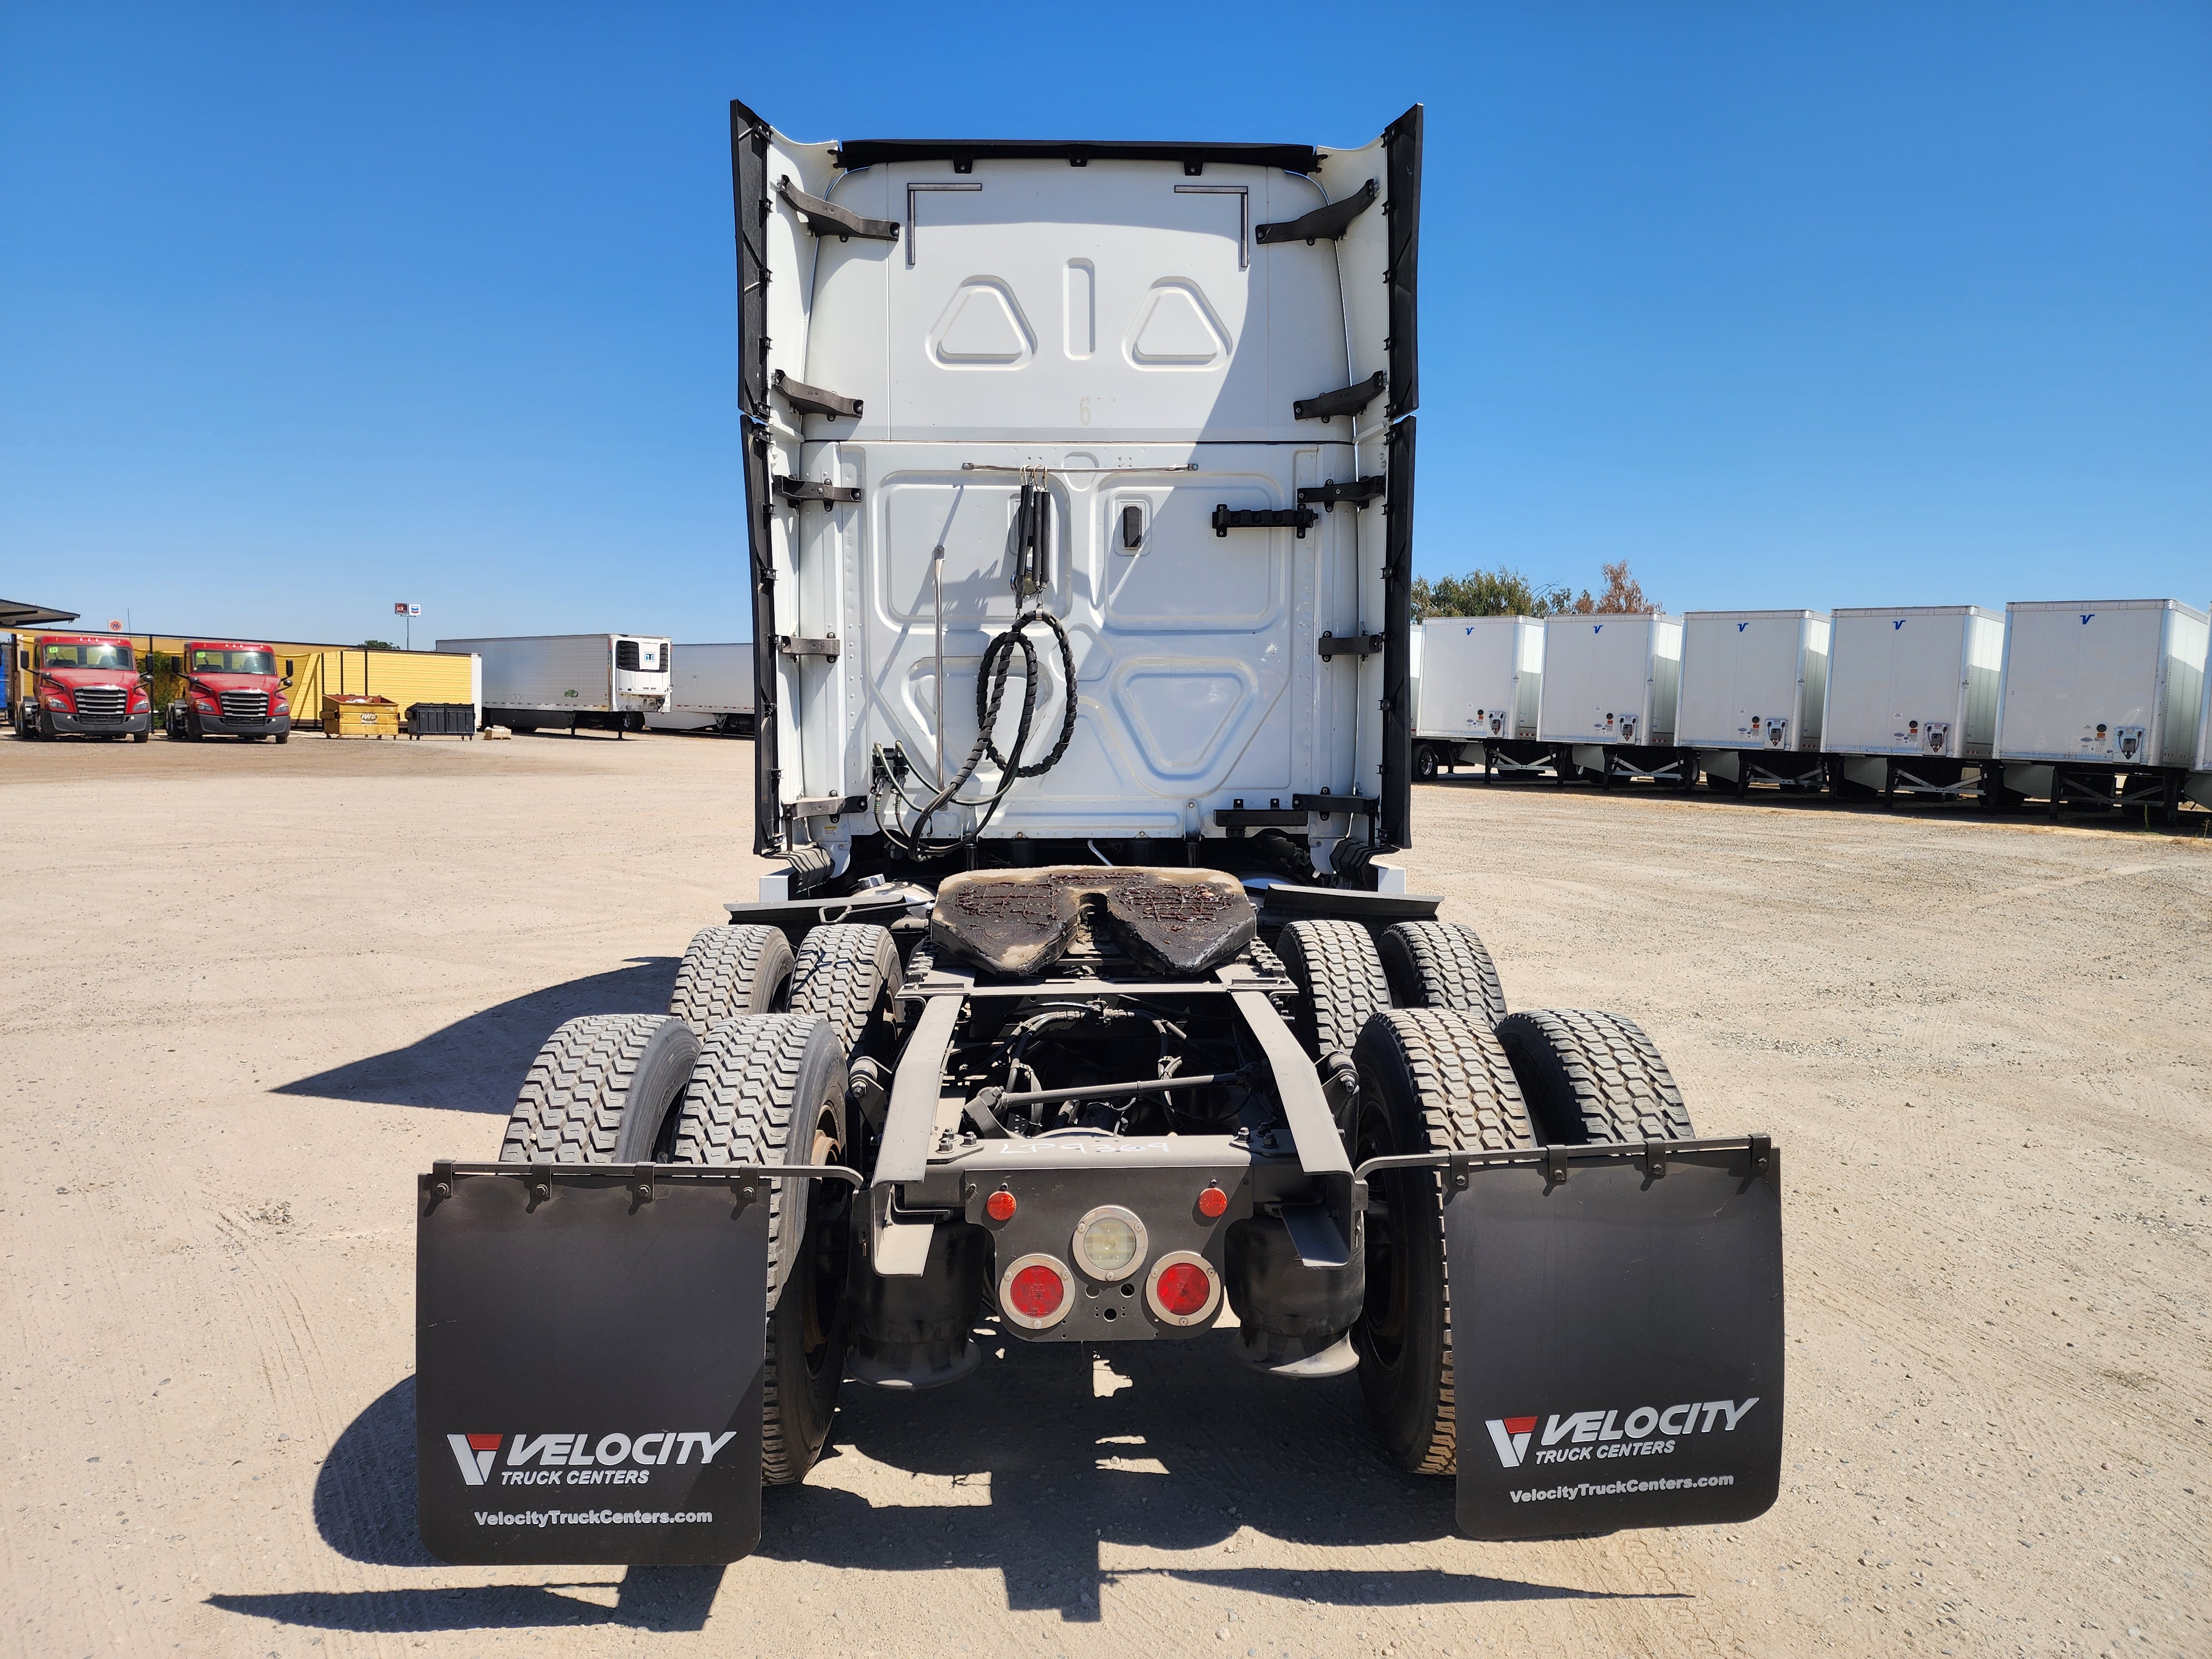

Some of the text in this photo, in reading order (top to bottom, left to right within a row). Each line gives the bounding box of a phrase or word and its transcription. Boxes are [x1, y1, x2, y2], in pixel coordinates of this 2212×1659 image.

[1541, 1398, 1759, 1446] VELOCITY
[507, 1432, 737, 1465] VELOCITY
[1536, 1440, 1676, 1465] TRUCK CENTERS
[501, 1470, 650, 1485] TRUCK CENTERS
[1510, 1475, 1734, 1503] VelocityTruckCenters.com
[474, 1509, 713, 1528] VelocityTruckCenters.com
